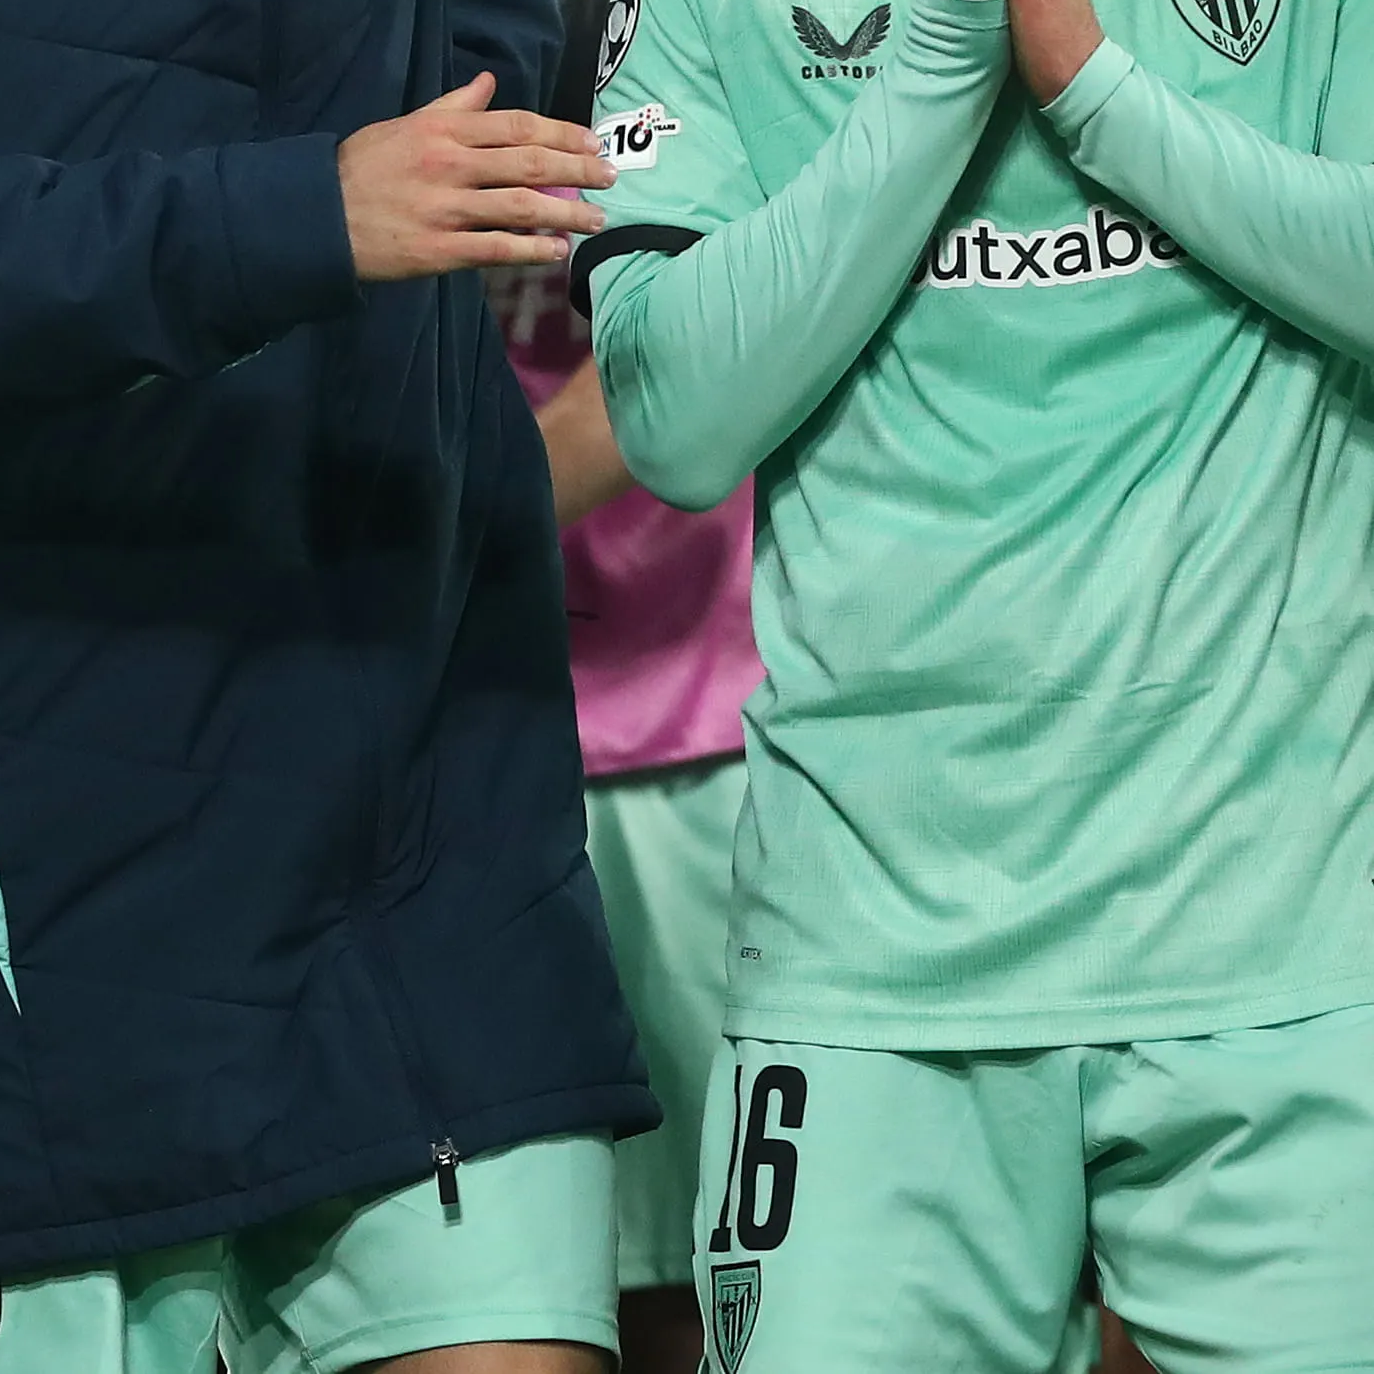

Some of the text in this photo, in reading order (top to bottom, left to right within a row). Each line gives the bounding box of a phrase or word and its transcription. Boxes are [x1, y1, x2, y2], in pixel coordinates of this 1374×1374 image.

[1212, 19, 1263, 58] BILBAO
[801, 64, 884, 80] CASTOR
[613, 124, 653, 153] 10
